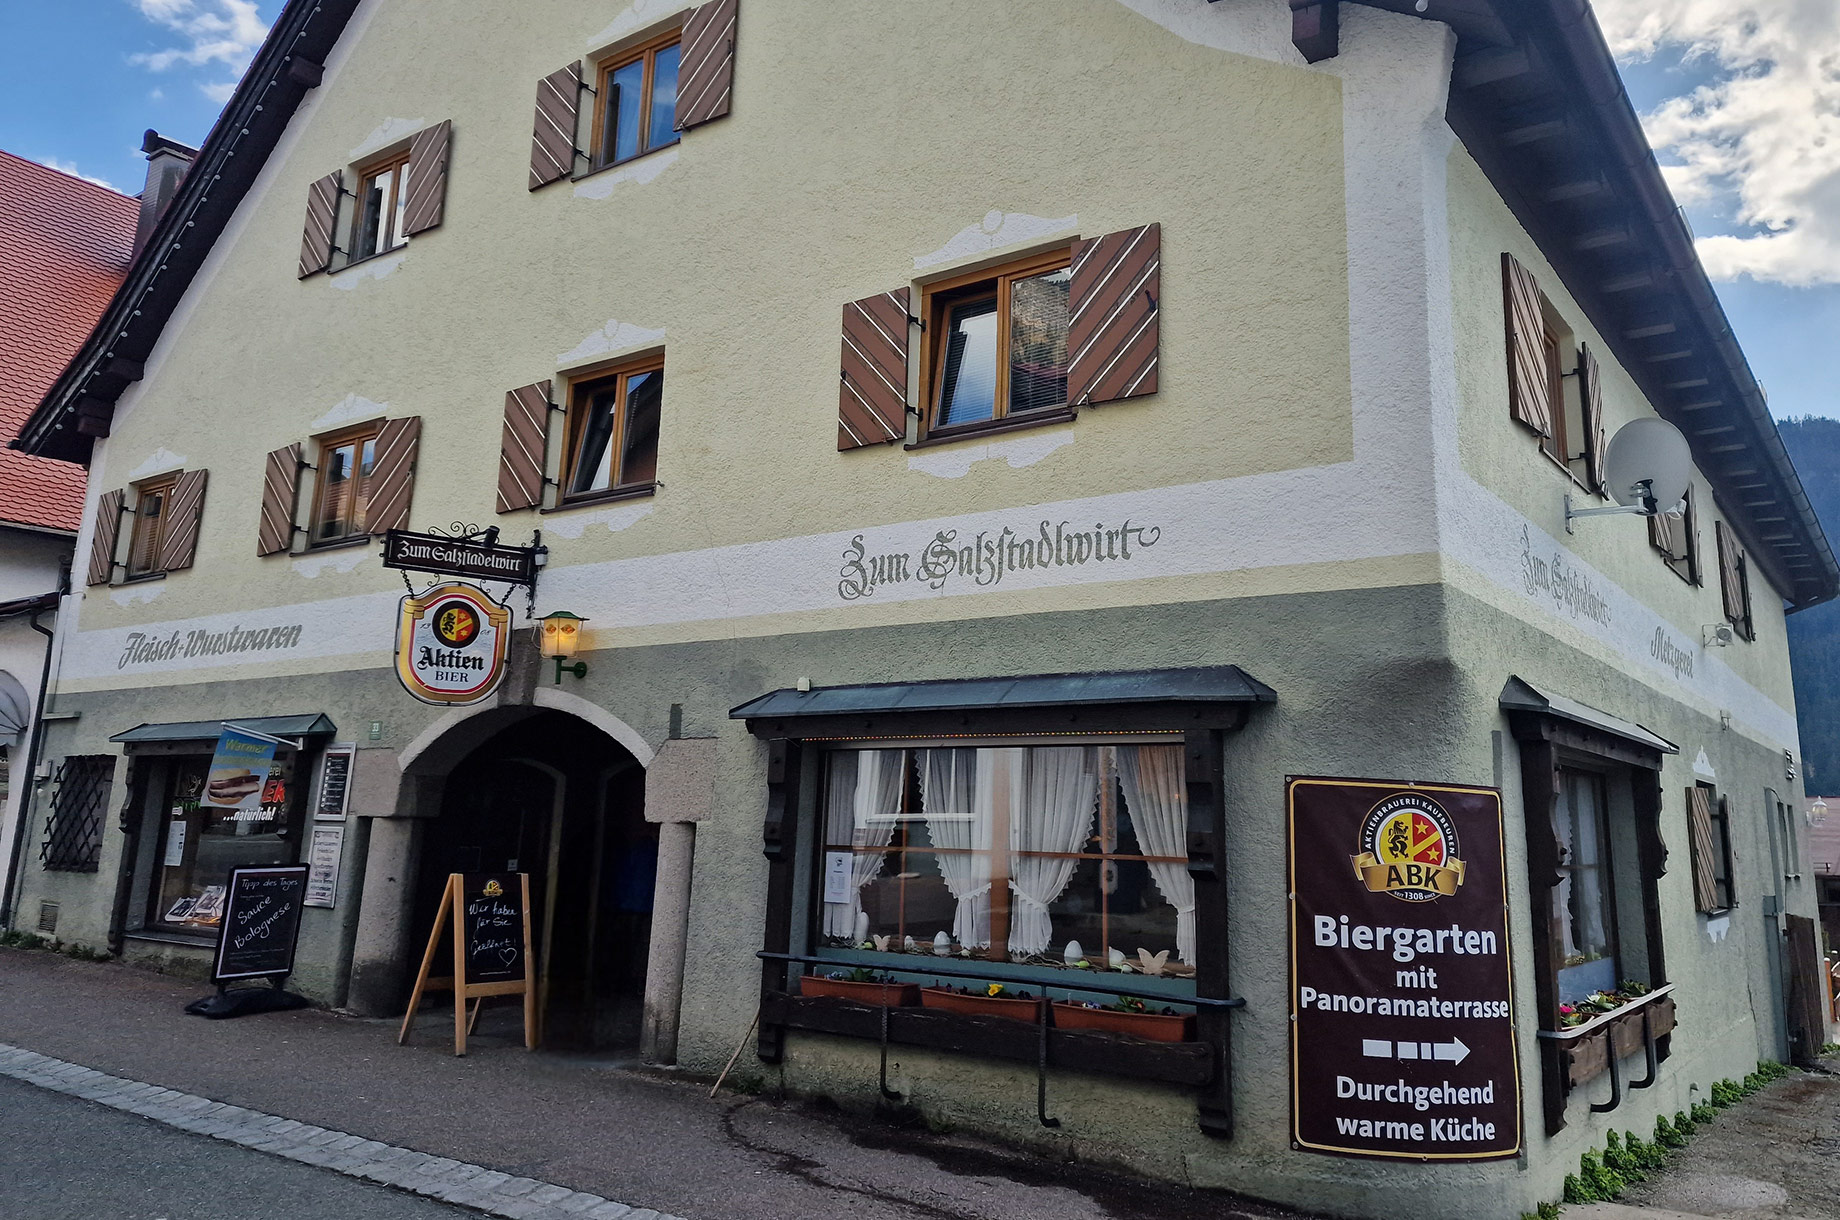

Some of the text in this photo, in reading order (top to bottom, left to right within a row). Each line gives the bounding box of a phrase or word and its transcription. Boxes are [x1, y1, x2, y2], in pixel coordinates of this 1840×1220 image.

[397, 540, 431, 559] Zum
[1520, 523, 1550, 597] Zum
[838, 534, 911, 600] Zum
[417, 646, 484, 671] Aktien
[1651, 625, 1695, 679] Metzgerei
[435, 671, 469, 682] BIER
[225, 738, 269, 754] Warmer
[1365, 798, 1455, 854] AKTIENBRAUEREI KAUFBEUREN
[241, 878, 260, 891] Tipp
[263, 879, 277, 887] des
[280, 877, 298, 891] Tages
[1386, 864, 1441, 890] ABK
[493, 901, 517, 915] haben
[1404, 891, 1424, 900] 1308
[237, 896, 272, 925] Sauce
[234, 902, 291, 949] Bolognese
[1314, 915, 1497, 962] Biergarten
[1396, 966, 1438, 989] mit
[1301, 986, 1509, 1019] Panoramaterrasse
[1336, 1075, 1494, 1111] Durchgehend
[1336, 1117, 1496, 1141] warme Küche
